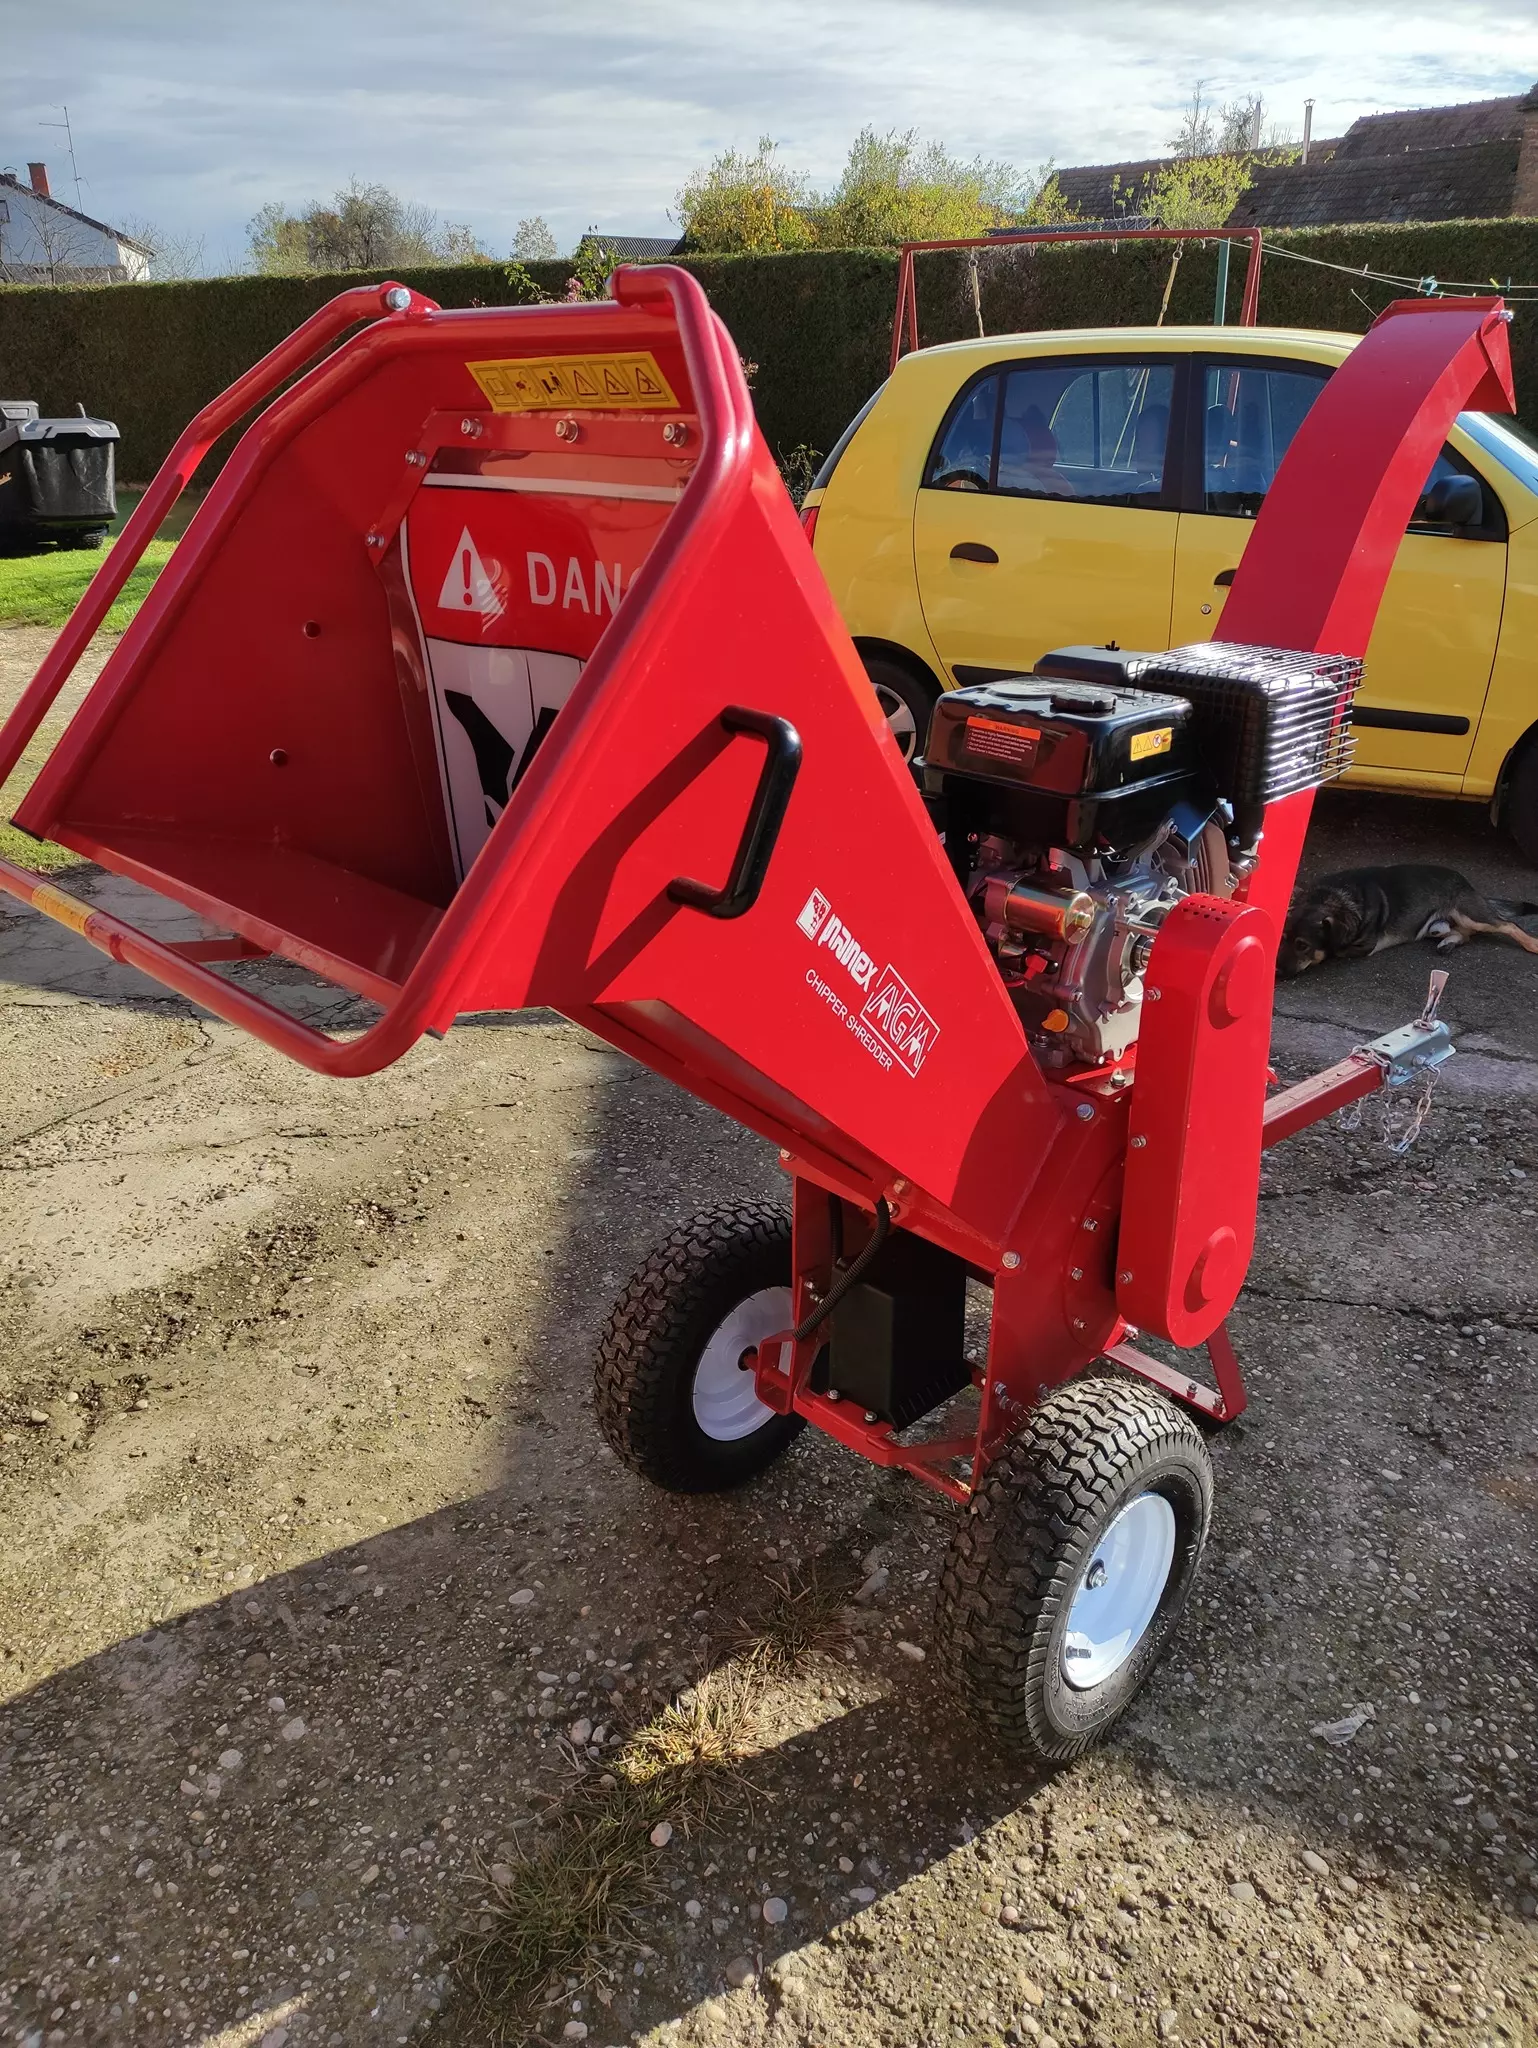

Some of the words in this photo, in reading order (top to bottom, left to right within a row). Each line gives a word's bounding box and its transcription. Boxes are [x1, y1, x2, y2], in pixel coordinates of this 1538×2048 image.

[526, 551, 643, 616] DAN
[805, 968, 849, 1021] CHIPPER
[845, 1014, 893, 1072] SHREDDER
[866, 981, 930, 1069] AGM
